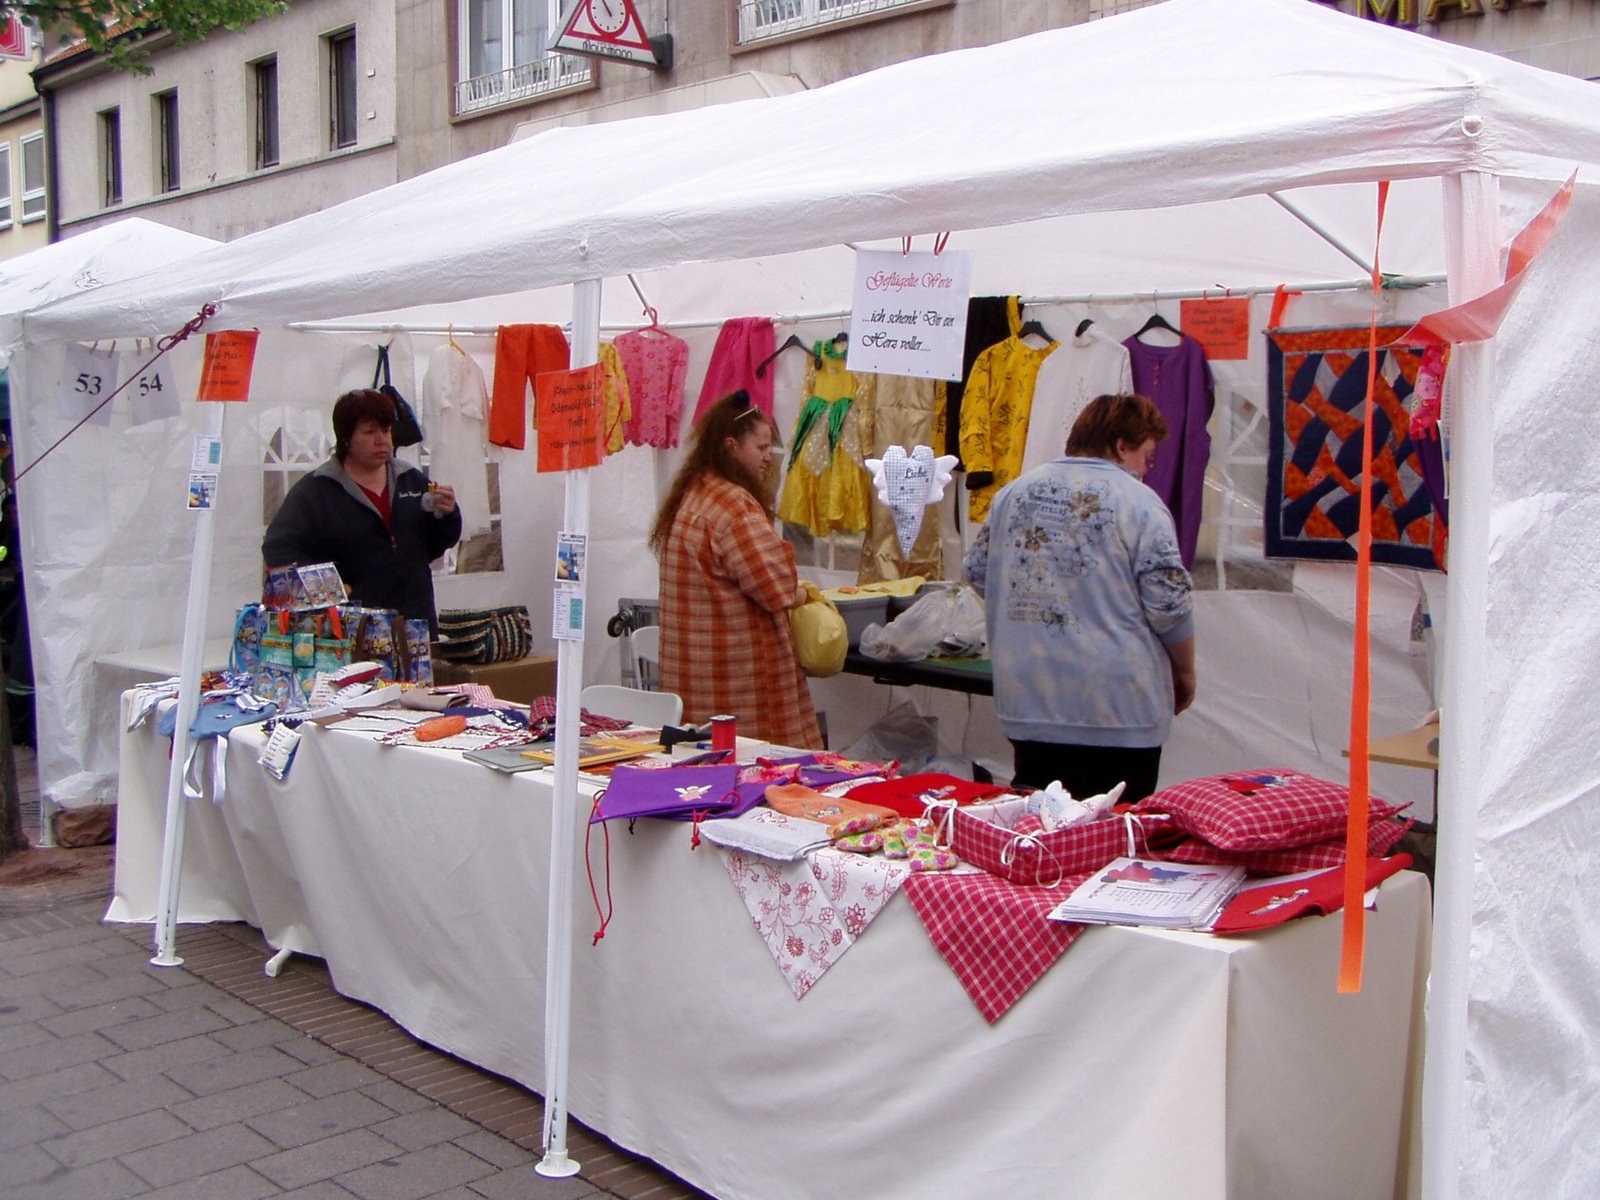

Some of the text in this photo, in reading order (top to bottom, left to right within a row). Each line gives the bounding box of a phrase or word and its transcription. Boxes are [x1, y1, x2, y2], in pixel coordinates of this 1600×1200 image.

[861, 331, 898, 349] Herz
[75, 373, 103, 395] 53
[140, 373, 163, 396] 54
